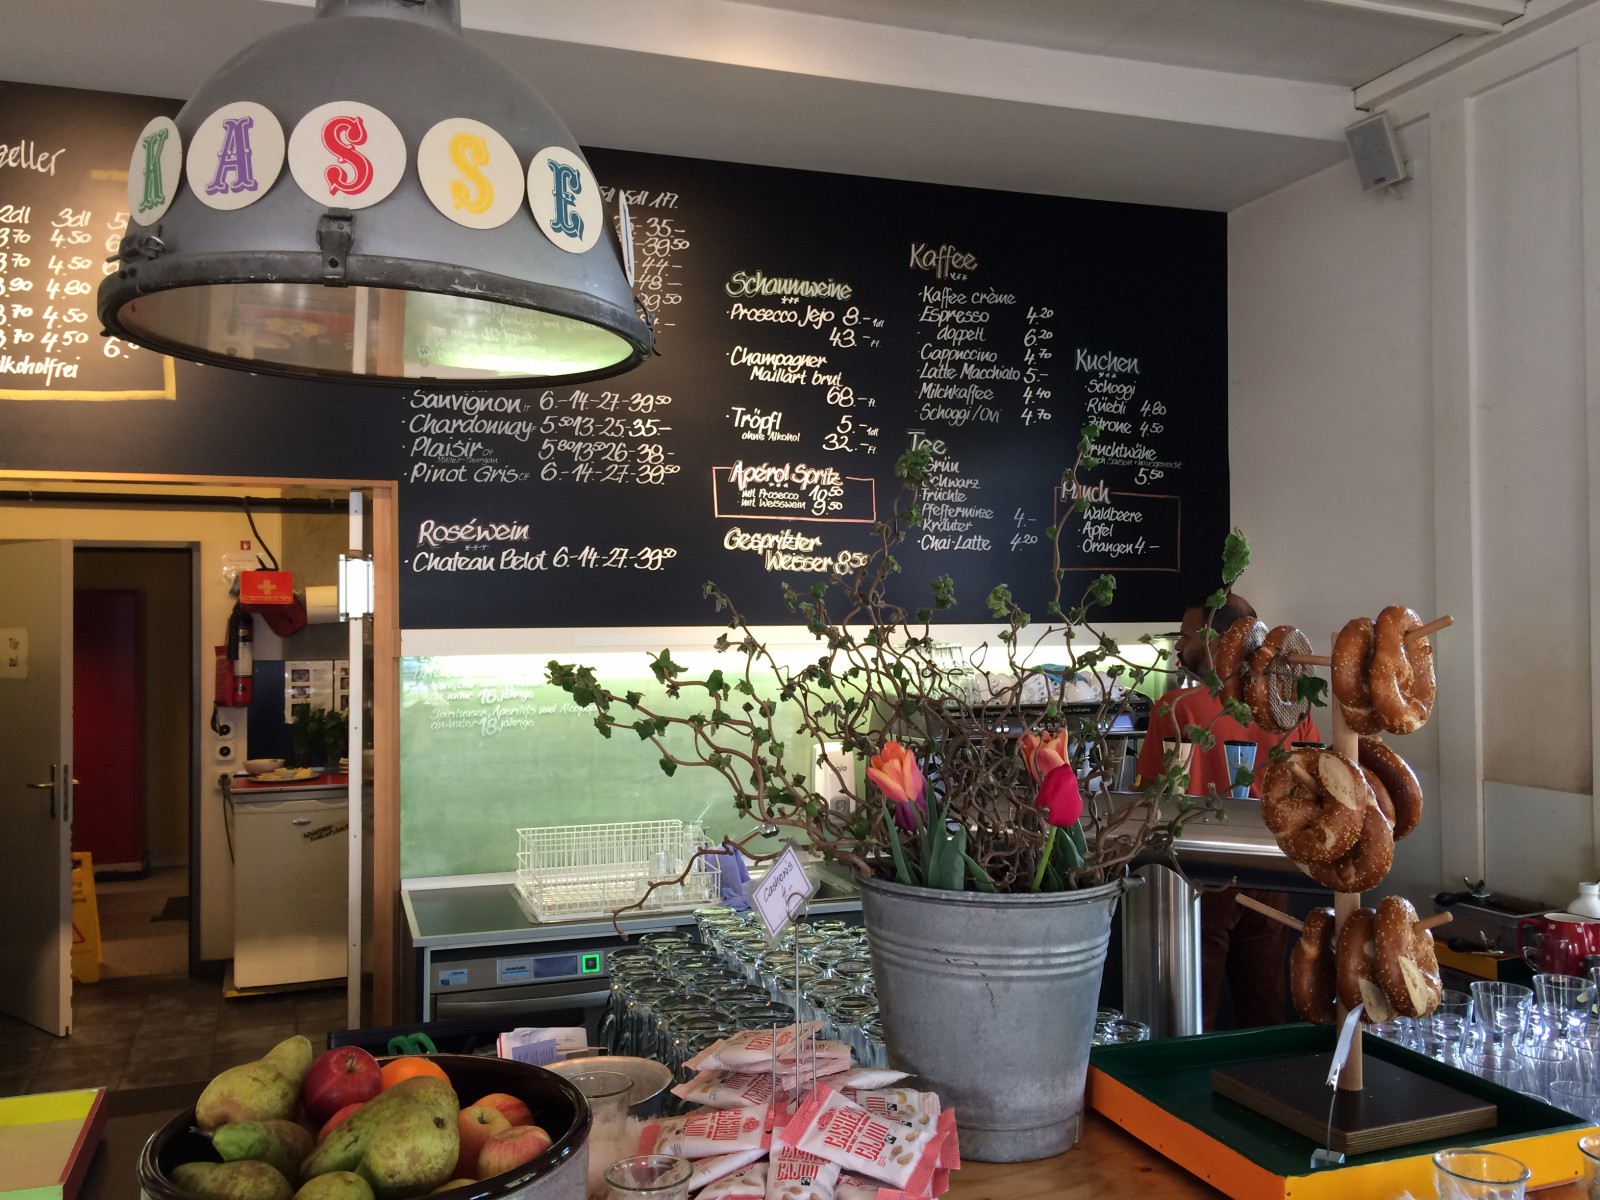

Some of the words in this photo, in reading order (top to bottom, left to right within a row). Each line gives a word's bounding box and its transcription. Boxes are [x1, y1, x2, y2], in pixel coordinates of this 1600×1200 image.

[51, 207, 92, 228] 3dl
[50, 228, 92, 249] 4.50
[48, 254, 92, 276] 4.50
[910, 242, 978, 280] Kaffee
[46, 278, 92, 300] 4.80
[725, 269, 852, 301] Schaumweine
[922, 285, 967, 309] Kaffee
[971, 286, 1017, 305] crème
[43, 305, 88, 329] 4.50
[730, 302, 798, 324] Prosecco
[797, 304, 835, 330] Jejo
[919, 305, 990, 327] Espresso
[1026, 306, 1054, 325] 4.20
[41, 331, 89, 353] 4.50
[936, 325, 987, 347] doppelt
[1023, 328, 1054, 347] 6.20
[730, 345, 828, 373] Champagner
[920, 343, 998, 367] Cappuccino
[1023, 348, 1053, 365] 4.70
[1075, 348, 1140, 375] Kuchen
[750, 366, 808, 385] Maillart
[811, 371, 844, 387] brut
[919, 362, 958, 379] Latte
[959, 362, 1021, 381] Macchiato
[918, 382, 995, 406] Milchkaffee
[1022, 386, 1052, 405] 4.40
[1087, 379, 1137, 401] Schoggi
[410, 390, 522, 416] Sauvignon
[1086, 397, 1128, 415] Rüebli
[1140, 400, 1167, 417] 4.80
[409, 413, 533, 442] Chardonnay
[731, 406, 783, 436] Tröpfl
[1021, 407, 1052, 426] 4.70
[741, 431, 766, 441] ohne
[768, 432, 801, 443] Alkohol
[1139, 420, 1165, 437] 4.50
[410, 436, 484, 458] Plaisir
[409, 462, 468, 484] Pinot
[473, 465, 519, 483] Gris
[728, 460, 791, 491] Apérol
[791, 463, 844, 490] Spritz
[1134, 467, 1164, 486] 5.50
[758, 487, 800, 501] Prosecco
[809, 485, 844, 501] 10.50
[922, 487, 968, 503] Früchte
[759, 499, 807, 510] Weisswein
[811, 500, 844, 517] 9.50
[922, 502, 994, 522] Pfefferminze
[1083, 506, 1144, 523] Waldbeere
[417, 518, 531, 548] Roséwein
[922, 517, 974, 533] Kräuter
[723, 526, 823, 556] Gespritzter
[1009, 532, 1039, 551] 4.20
[1082, 538, 1133, 558] Orangen
[413, 551, 496, 572] Chateau
[499, 548, 549, 571] Belot
[764, 550, 834, 572] Weisser
[479, 688, 498, 705] 16
[479, 716, 498, 737] 18
